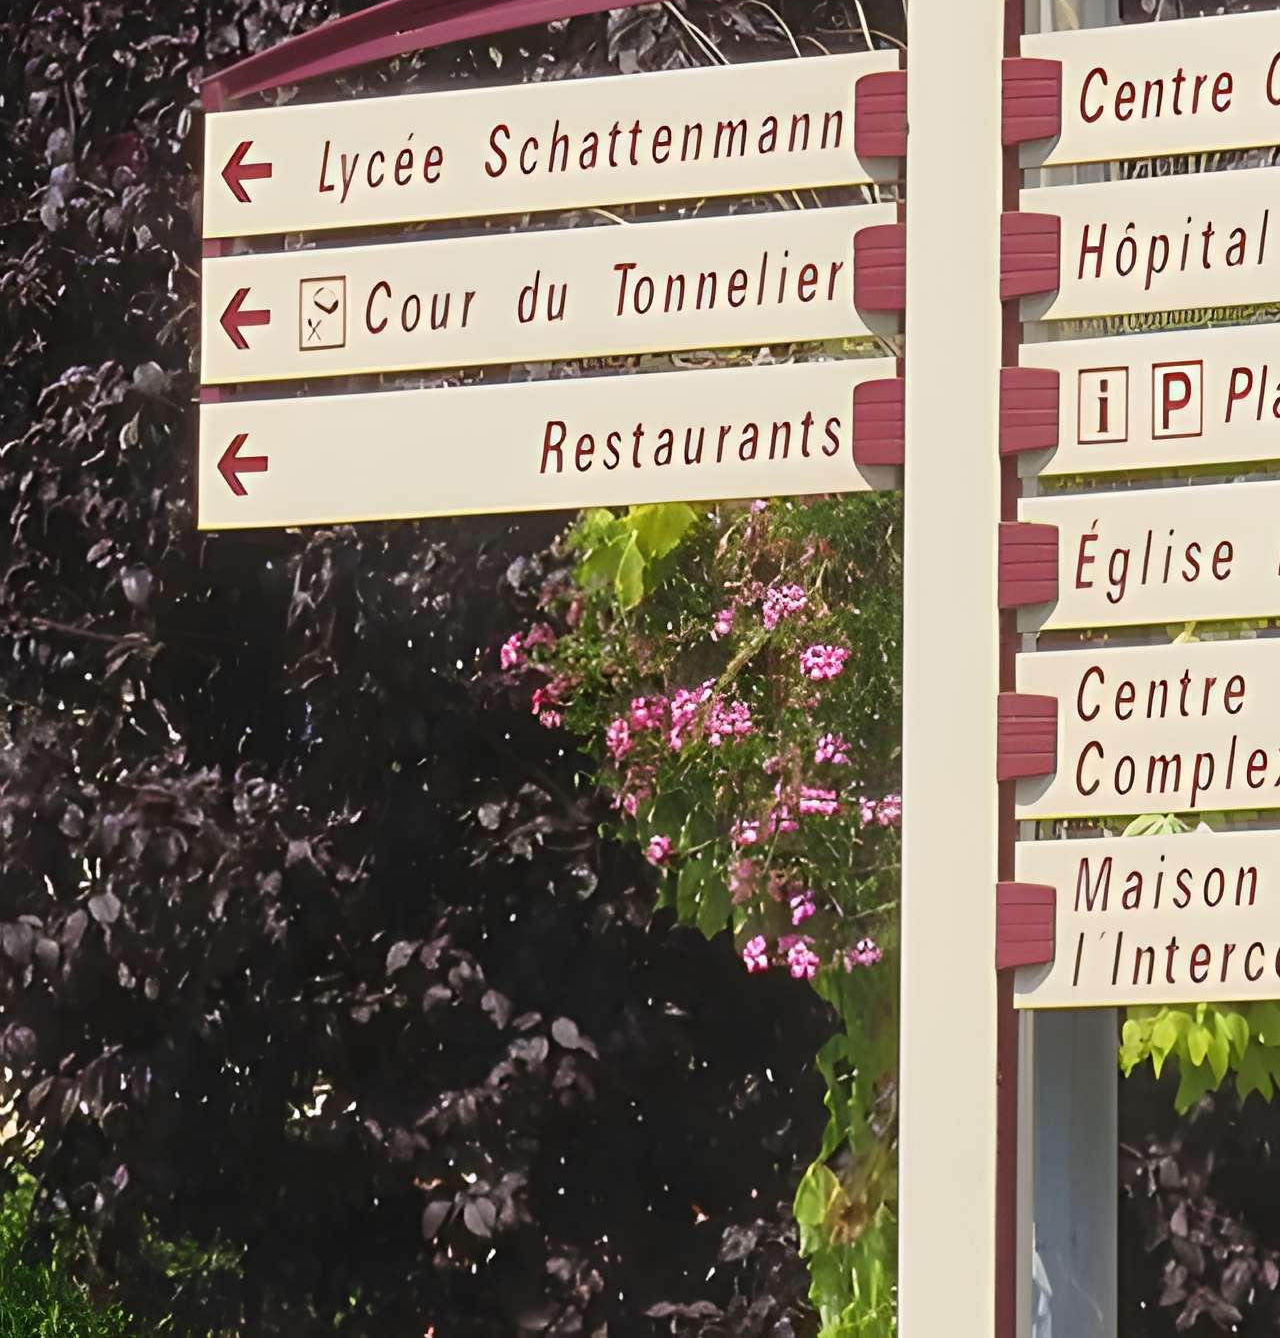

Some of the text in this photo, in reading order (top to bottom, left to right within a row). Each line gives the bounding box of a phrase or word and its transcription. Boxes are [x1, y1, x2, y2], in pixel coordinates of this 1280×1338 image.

[1079, 67, 1234, 124] Centre
[318, 108, 844, 204] Lycée Schattenmann
[1077, 208, 1269, 291] Hôpital
[365, 249, 844, 335] Cour du Tonnelier
[539, 410, 841, 474] Restaurants
[1075, 518, 1234, 605] Église
[1076, 665, 1246, 723] Centre
[1074, 854, 1258, 912] Maison
